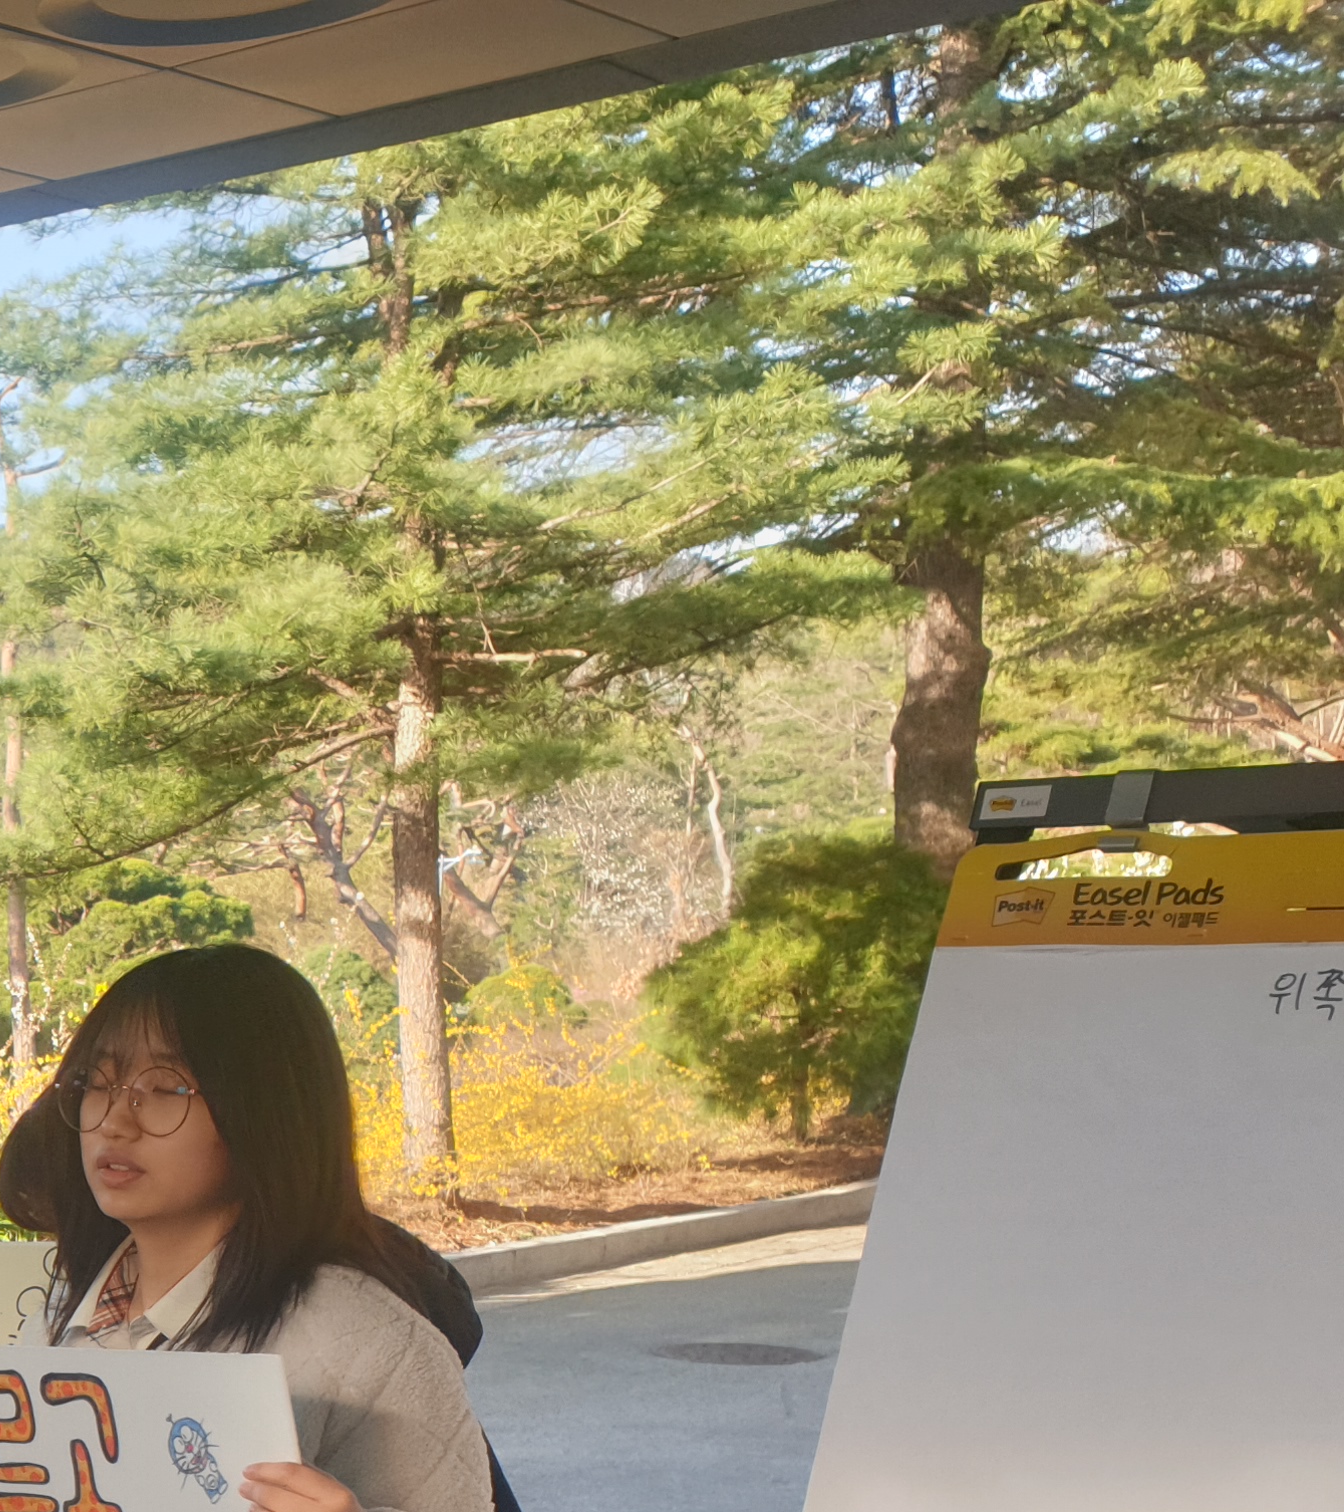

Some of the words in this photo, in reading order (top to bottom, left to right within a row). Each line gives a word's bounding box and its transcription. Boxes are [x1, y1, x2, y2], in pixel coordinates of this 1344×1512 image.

[1072, 880, 1152, 907] Easel
[1155, 878, 1225, 907] Pads
[997, 897, 1045, 914] Post-it
[1067, 909, 1154, 928] 포스트-잇
